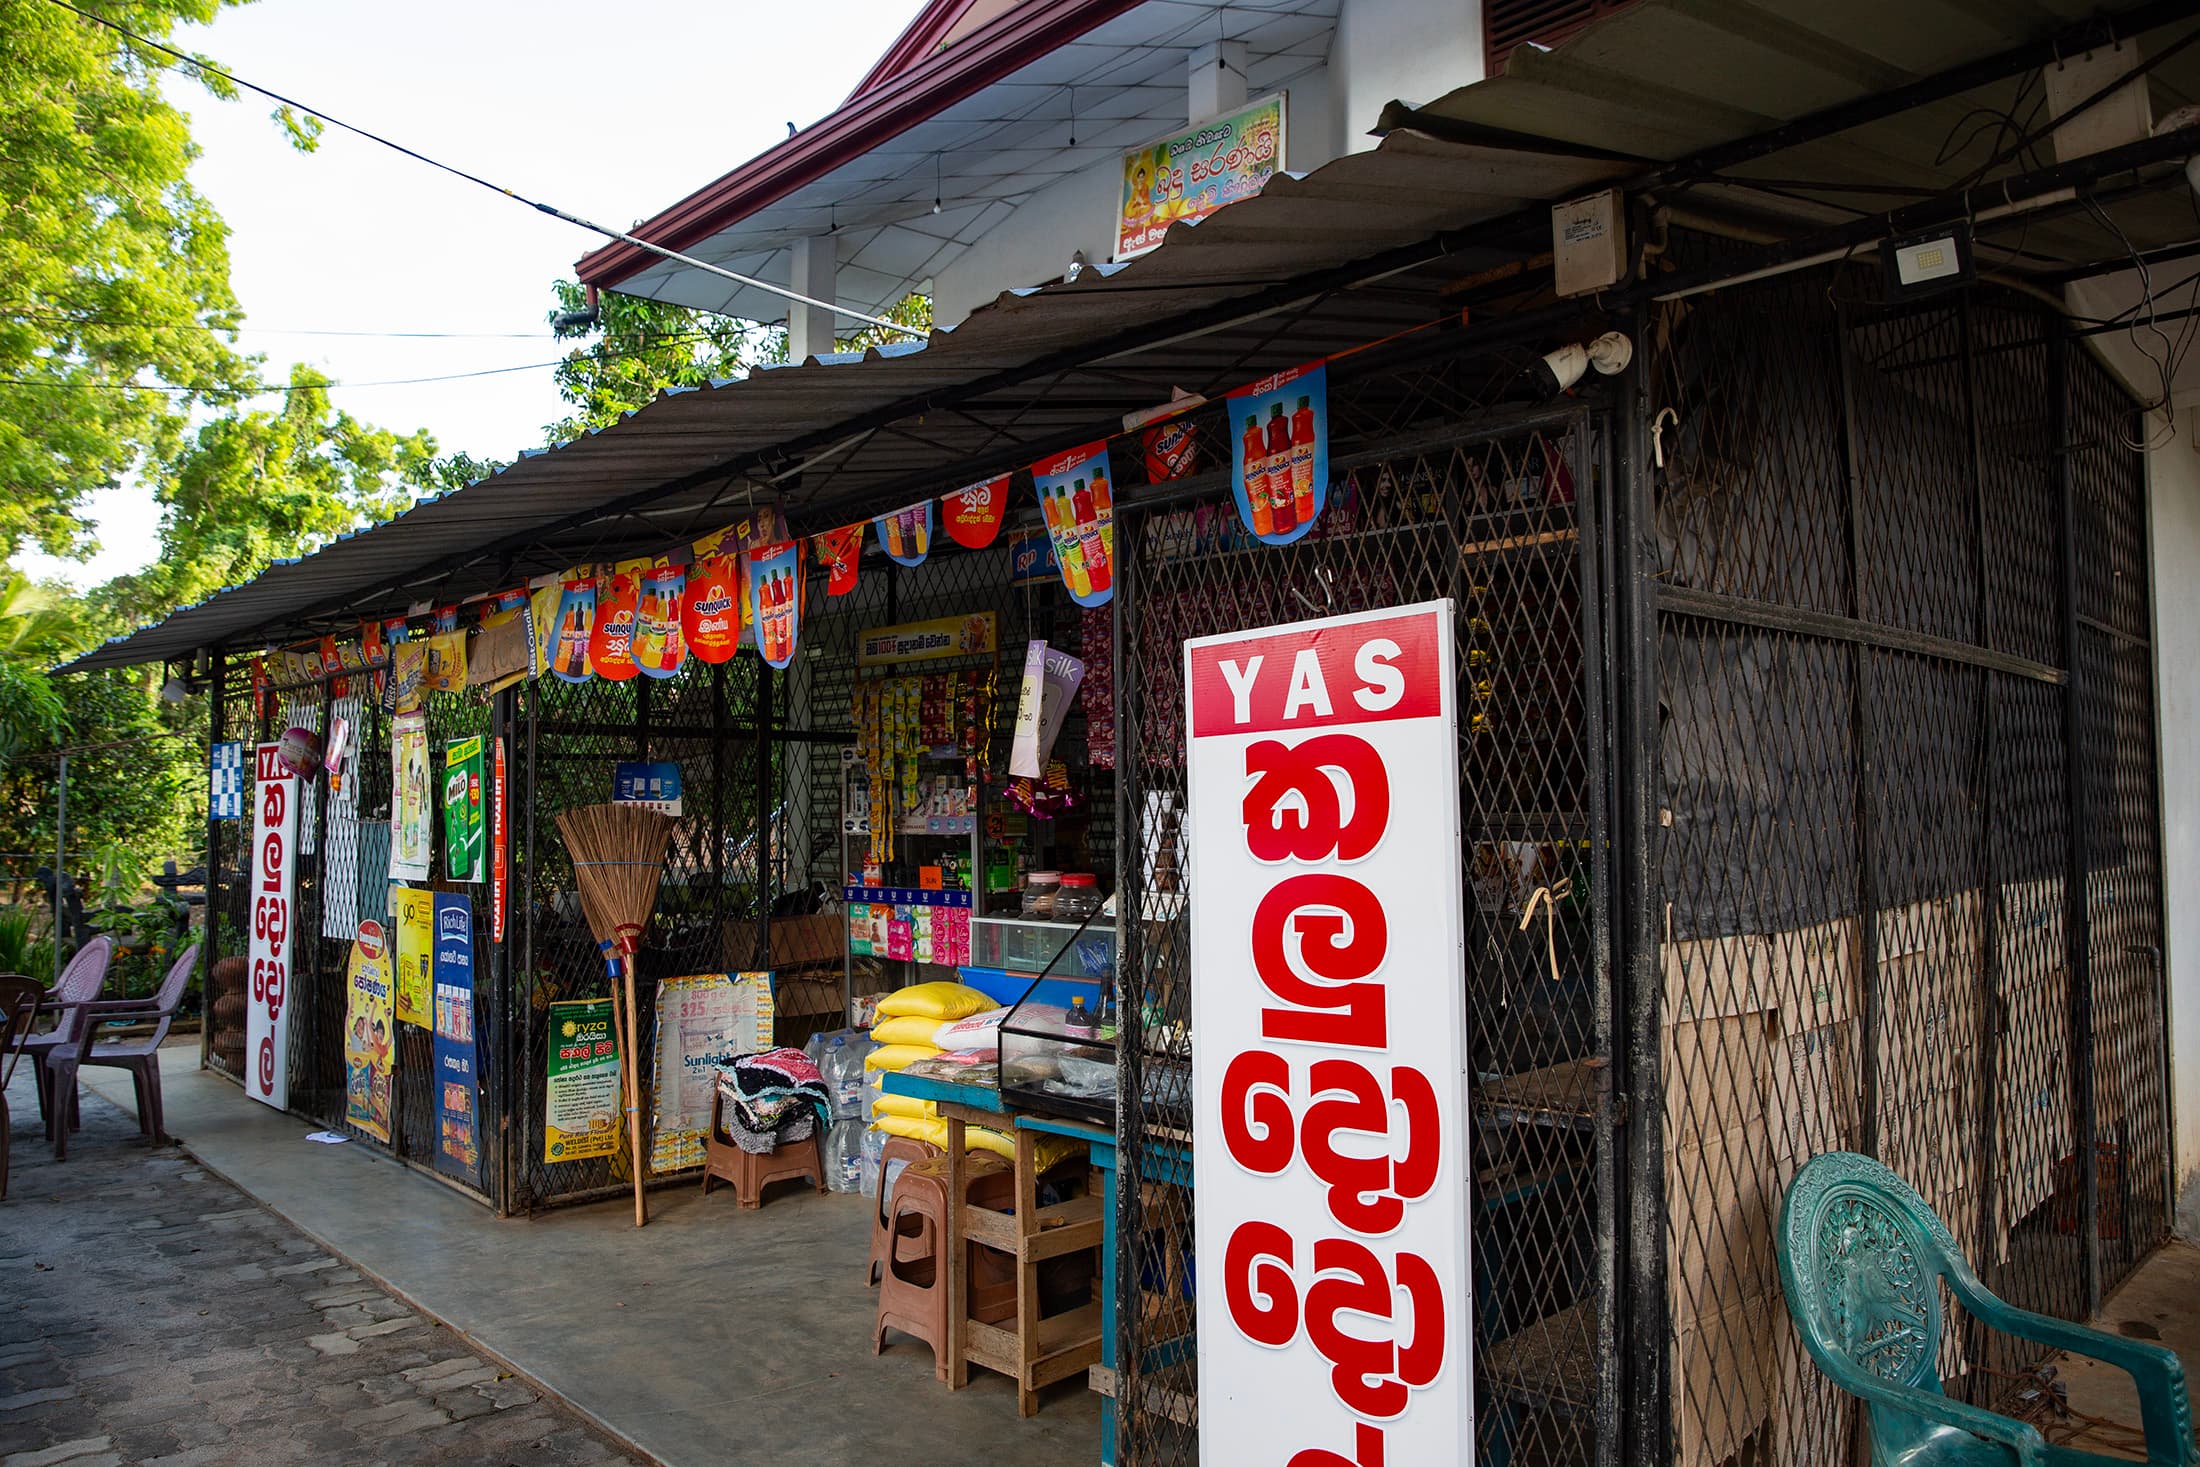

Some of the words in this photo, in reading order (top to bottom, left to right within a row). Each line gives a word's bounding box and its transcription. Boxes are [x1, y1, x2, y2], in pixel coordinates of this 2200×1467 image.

[694, 597, 731, 612] SUNQUICK
[603, 623, 631, 635] SUNQU
[1044, 656, 1078, 682] silk
[1218, 638, 1406, 725] YAS
[448, 779, 466, 801] MILO
[684, 1051, 732, 1067] Sunlight
[1221, 1050, 1446, 1467] දොදො
